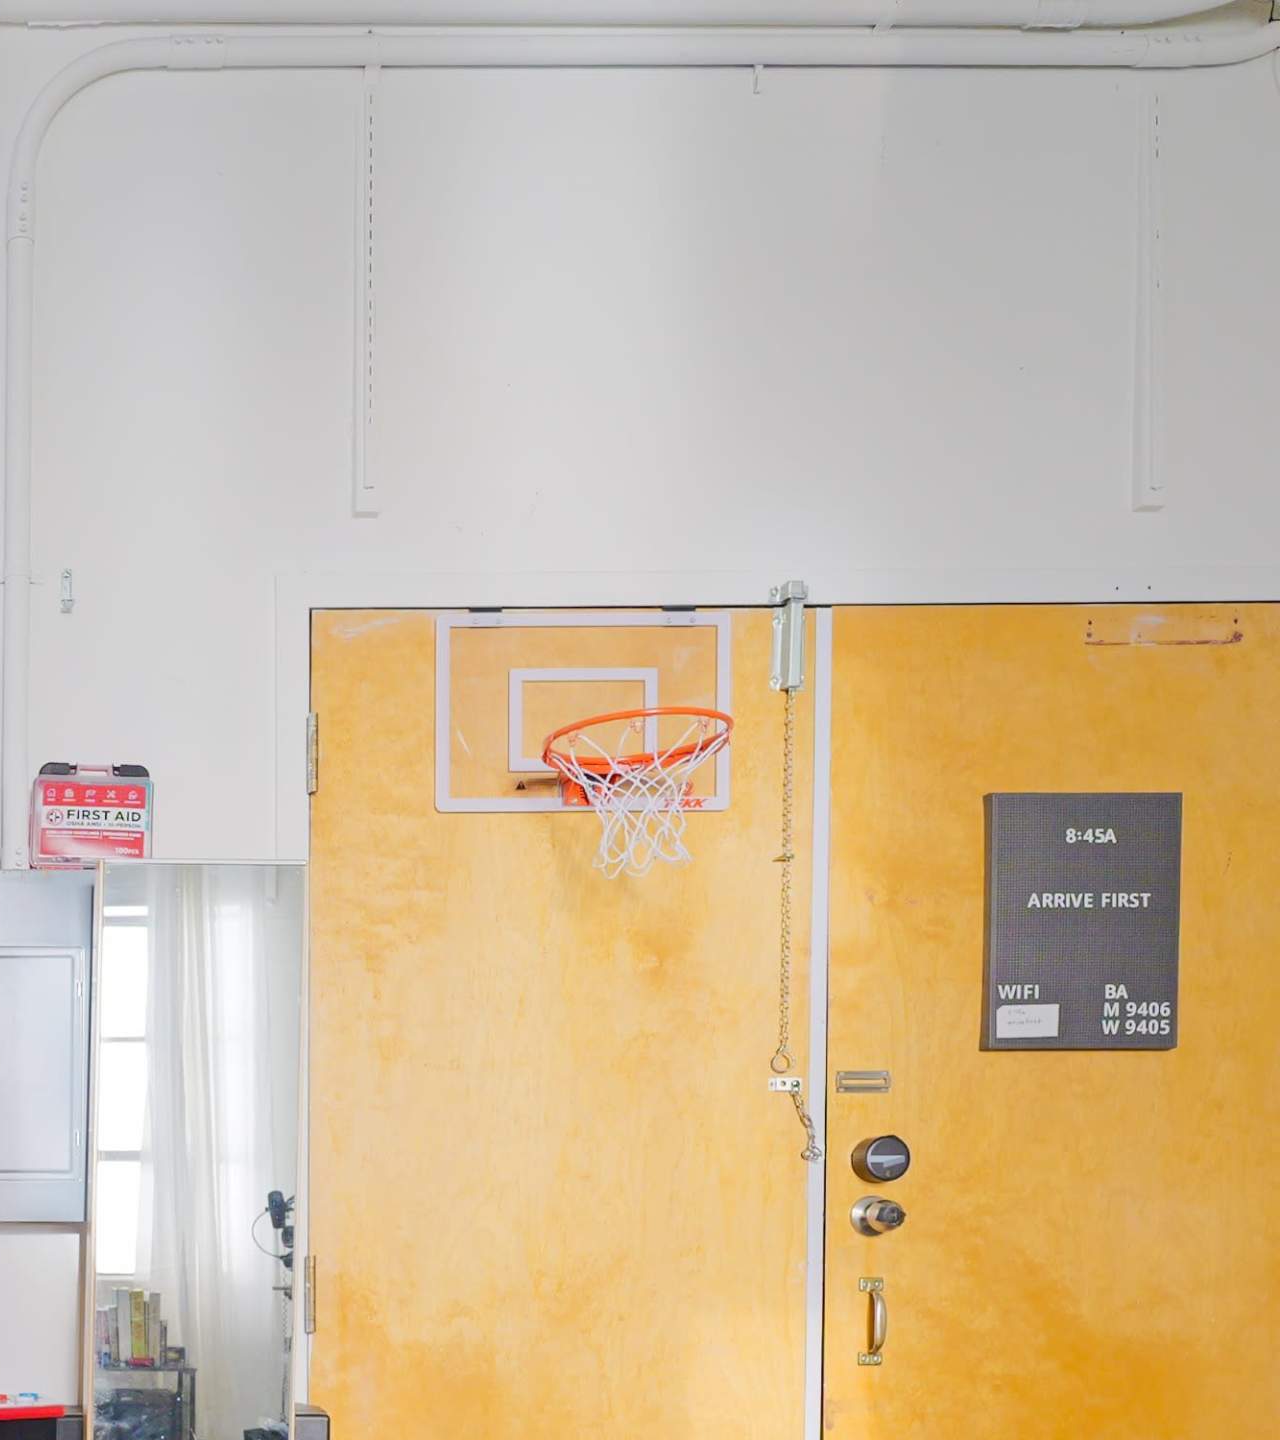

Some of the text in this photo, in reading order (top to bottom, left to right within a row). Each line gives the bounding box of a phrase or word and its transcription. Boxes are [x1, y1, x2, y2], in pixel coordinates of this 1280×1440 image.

[67, 809, 142, 822] FIRST AID
[1065, 828, 1117, 844] 8:45A
[1027, 893, 1151, 908] ARRIVE FIRST
[998, 984, 1039, 999] WIFI
[1104, 984, 1128, 999] BA
[1103, 1002, 1171, 1017] M 9406
[1102, 1020, 1170, 1035] W 9405
